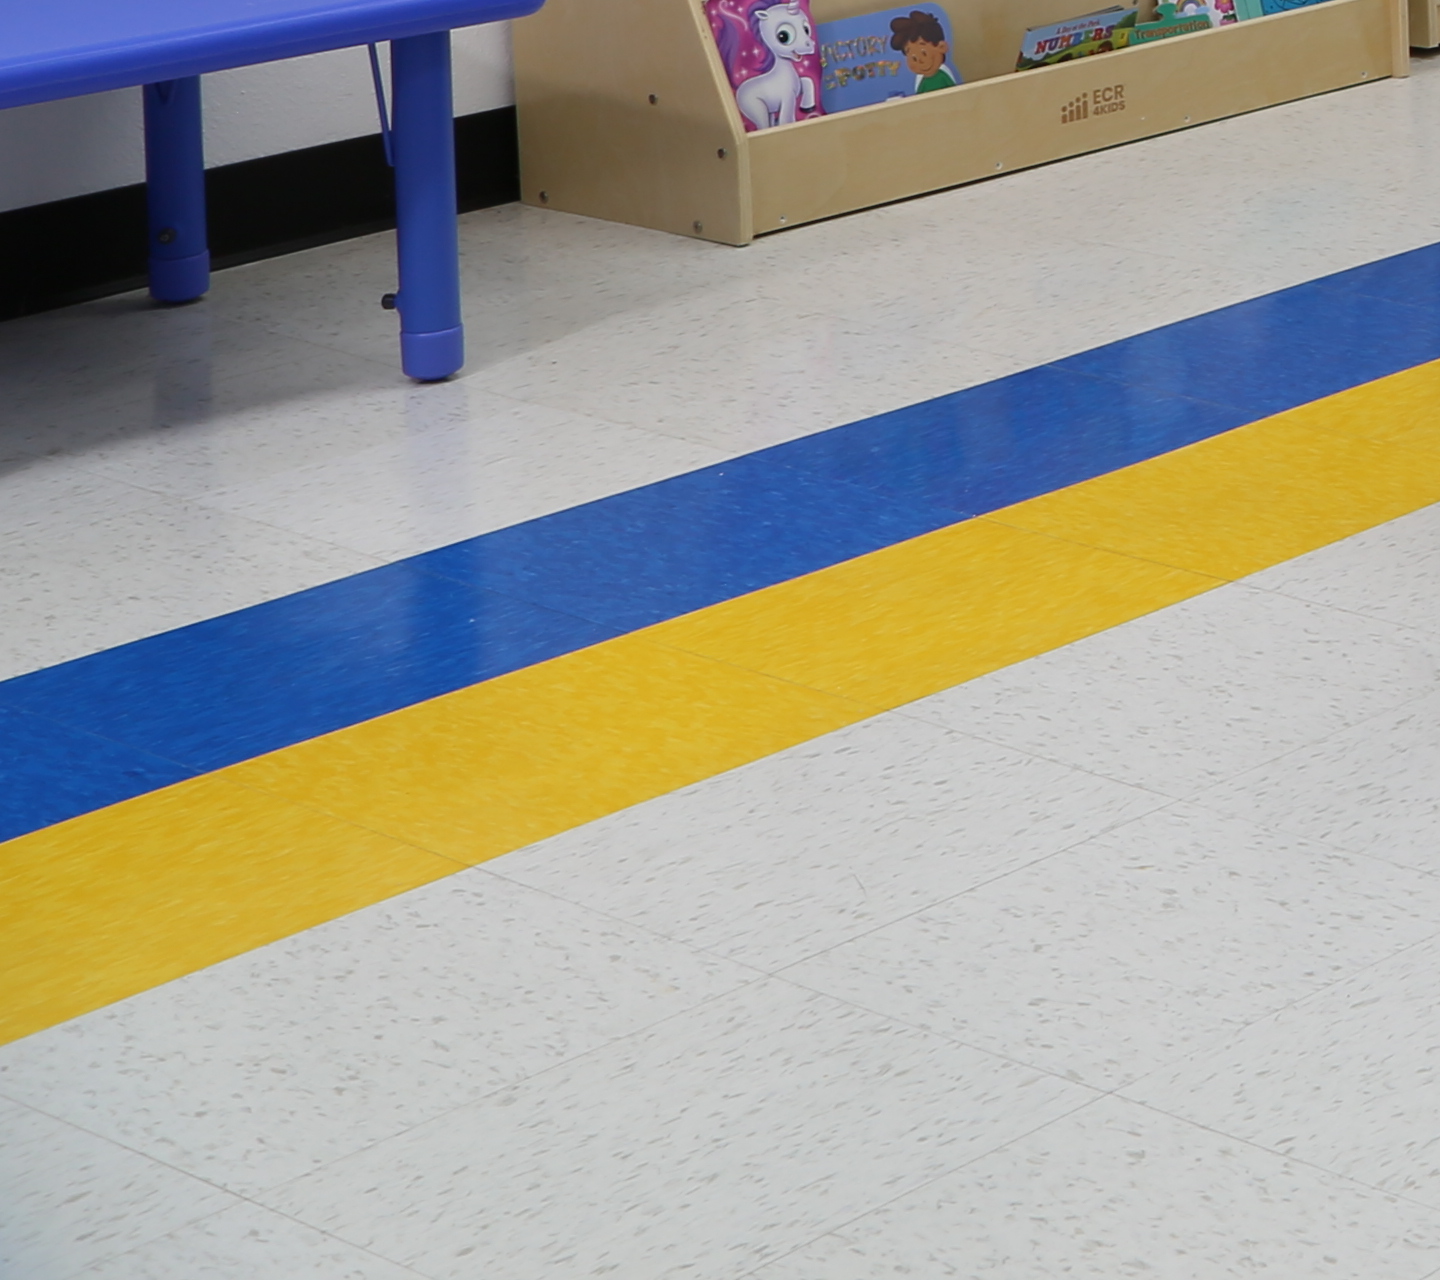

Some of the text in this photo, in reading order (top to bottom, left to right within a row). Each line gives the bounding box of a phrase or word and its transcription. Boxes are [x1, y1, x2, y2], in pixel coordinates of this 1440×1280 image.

[1035, 26, 1115, 56] NUMBERS
[1134, 19, 1210, 41] Transportation
[1093, 84, 1125, 106] ECR
[1093, 100, 1126, 117] 4KIDS
